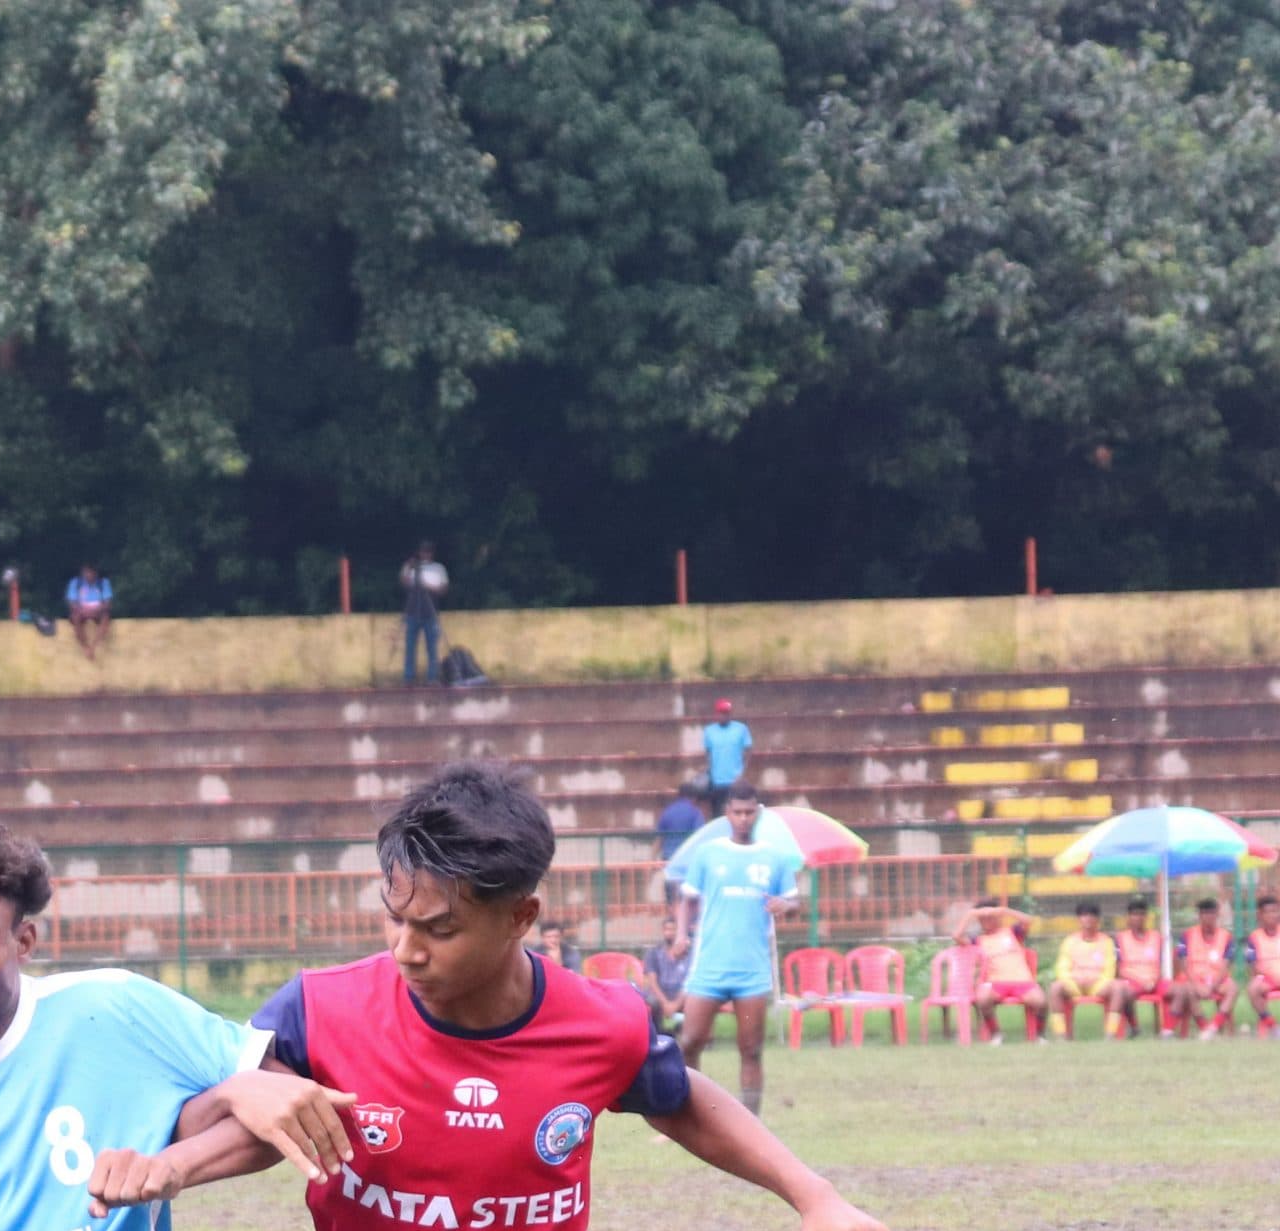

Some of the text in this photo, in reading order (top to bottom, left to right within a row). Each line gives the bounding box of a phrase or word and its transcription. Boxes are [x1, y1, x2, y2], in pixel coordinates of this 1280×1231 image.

[355, 1109, 394, 1125] TFA
[445, 1110, 505, 1130] TATA
[44, 1105, 95, 1186] 8
[341, 1162, 585, 1230] TATA STEEL
